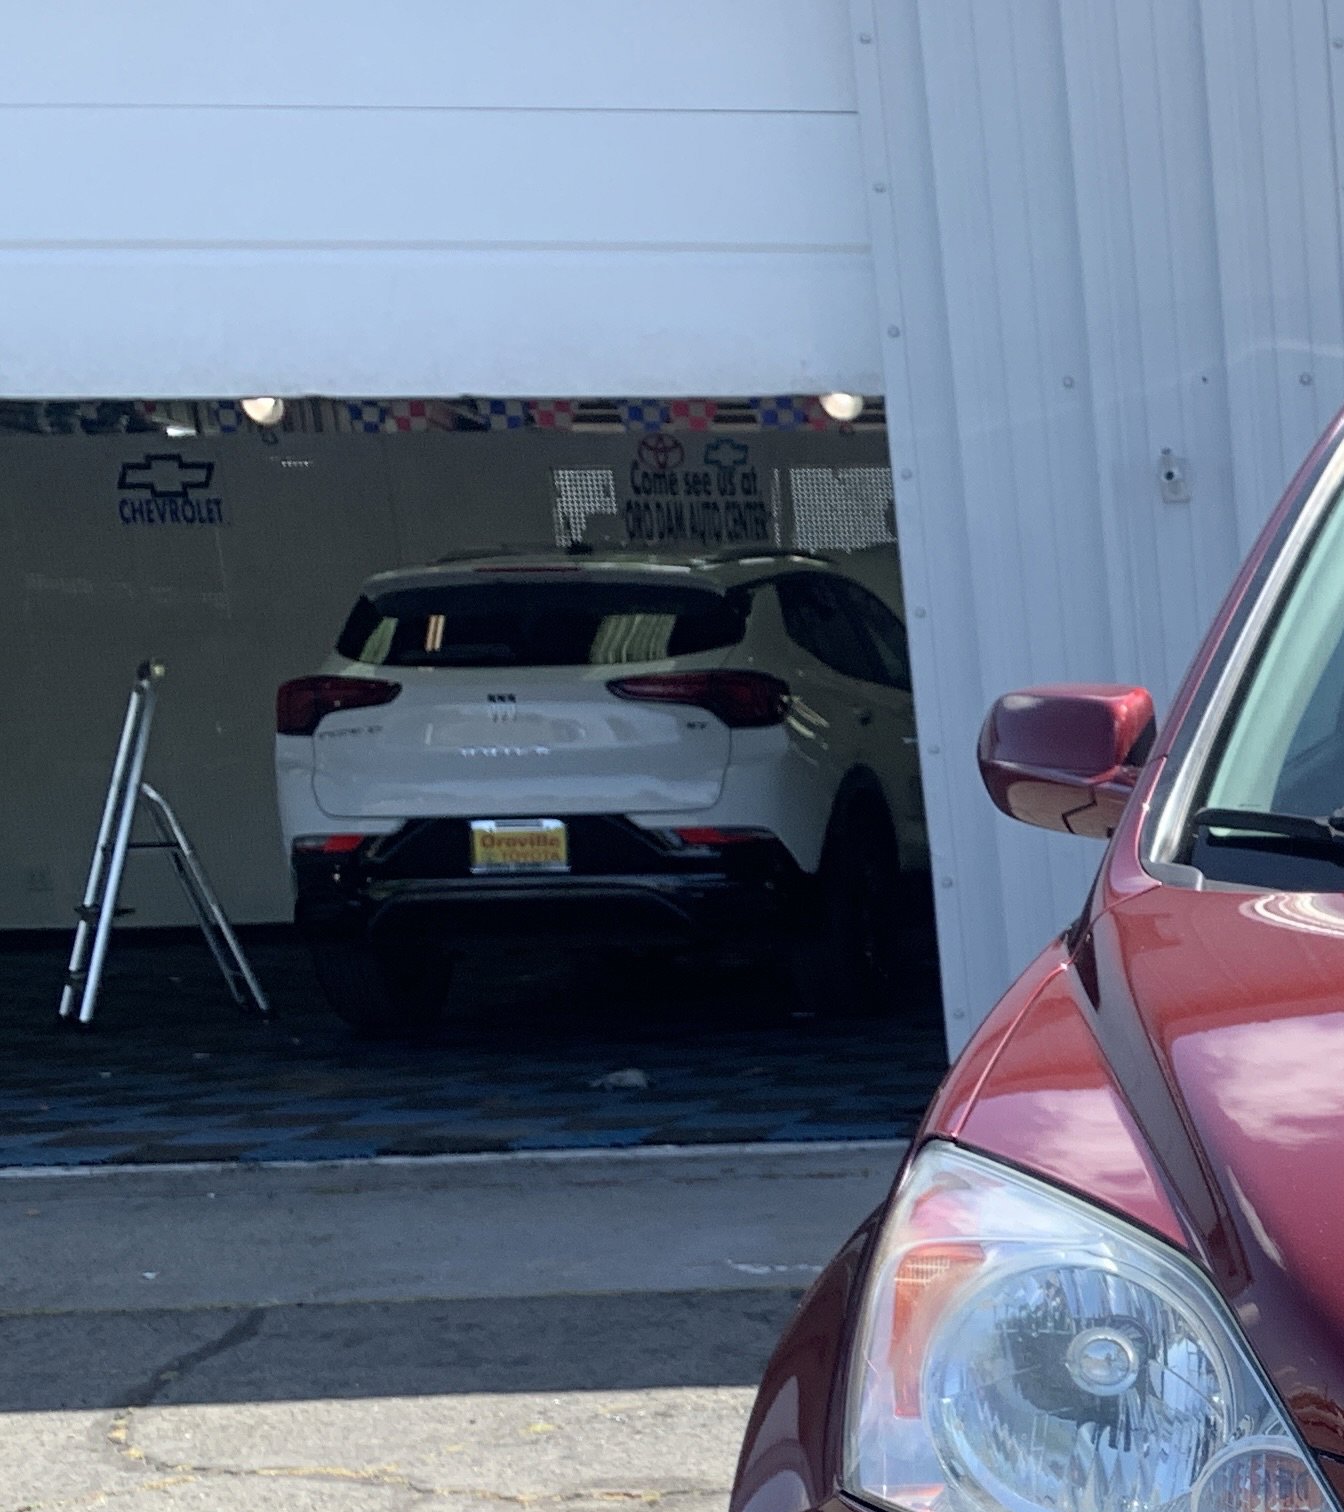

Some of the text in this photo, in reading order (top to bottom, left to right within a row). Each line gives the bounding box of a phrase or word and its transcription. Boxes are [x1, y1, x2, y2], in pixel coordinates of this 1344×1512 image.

[630, 460, 758, 496] Come see us at
[119, 498, 223, 524] CHEVROLET
